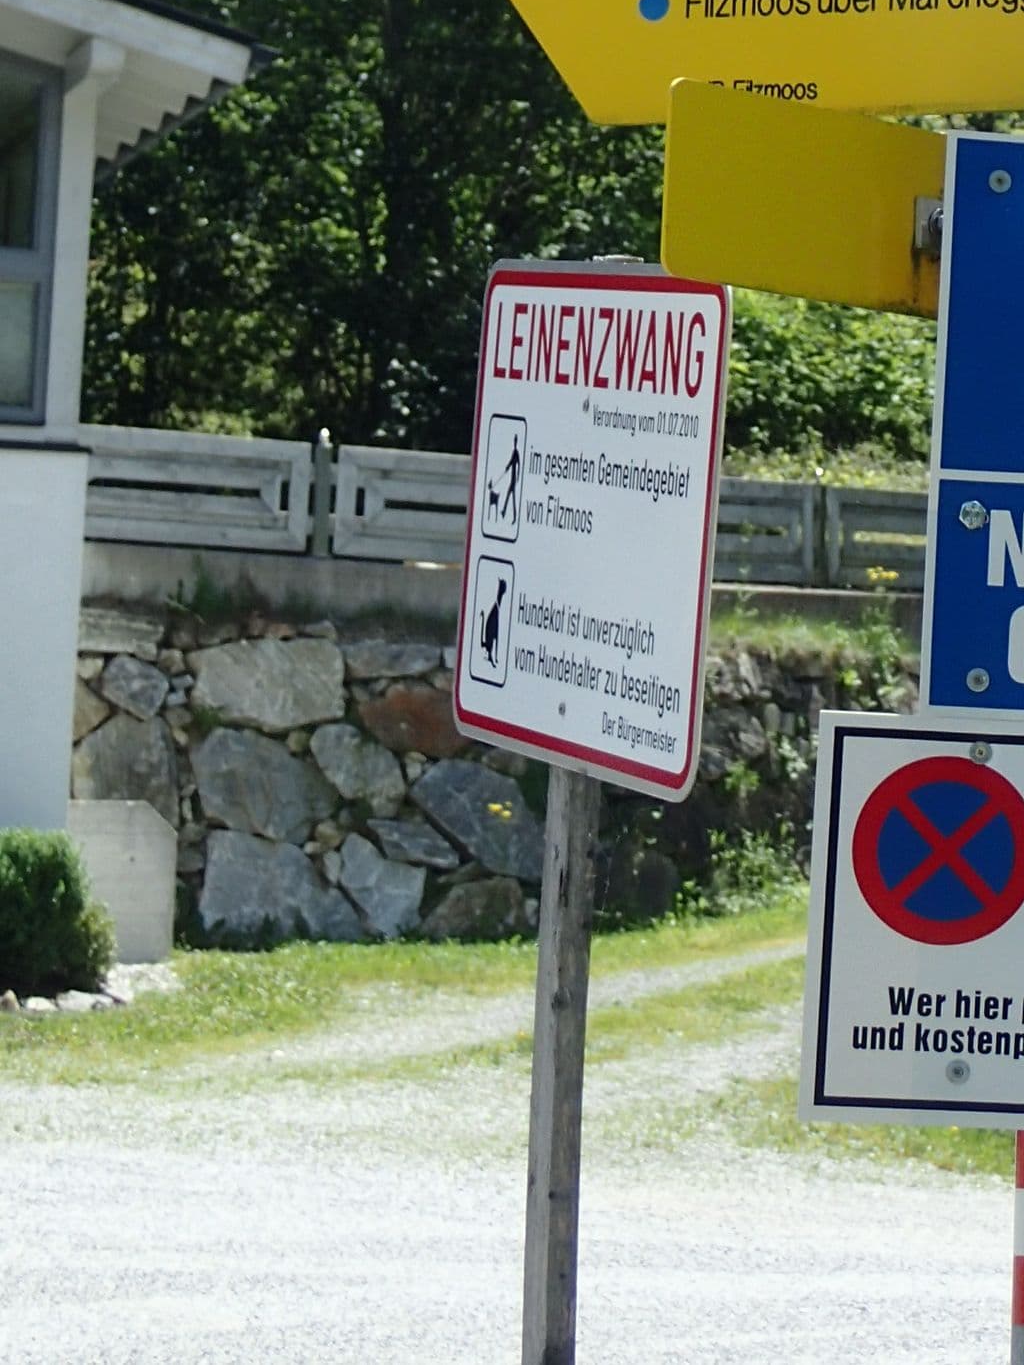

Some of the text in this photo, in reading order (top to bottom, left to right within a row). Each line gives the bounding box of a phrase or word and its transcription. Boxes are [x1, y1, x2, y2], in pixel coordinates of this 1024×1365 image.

[493, 301, 706, 398] LEINENZWANG
[592, 404, 699, 439] Verordnung vom 01.07.2010
[528, 445, 690, 502] im gesamten Gemeindegebiet
[526, 495, 593, 534] von Filzmoos
[517, 592, 655, 660] Hundekot ist unverzüglich
[514, 643, 681, 718] vom Hundehalter zu beseitigen
[601, 711, 677, 754] Der Bürgermeister
[887, 986, 946, 1019] Wer
[955, 989, 1013, 1022] hier
[852, 1023, 904, 1051] und
